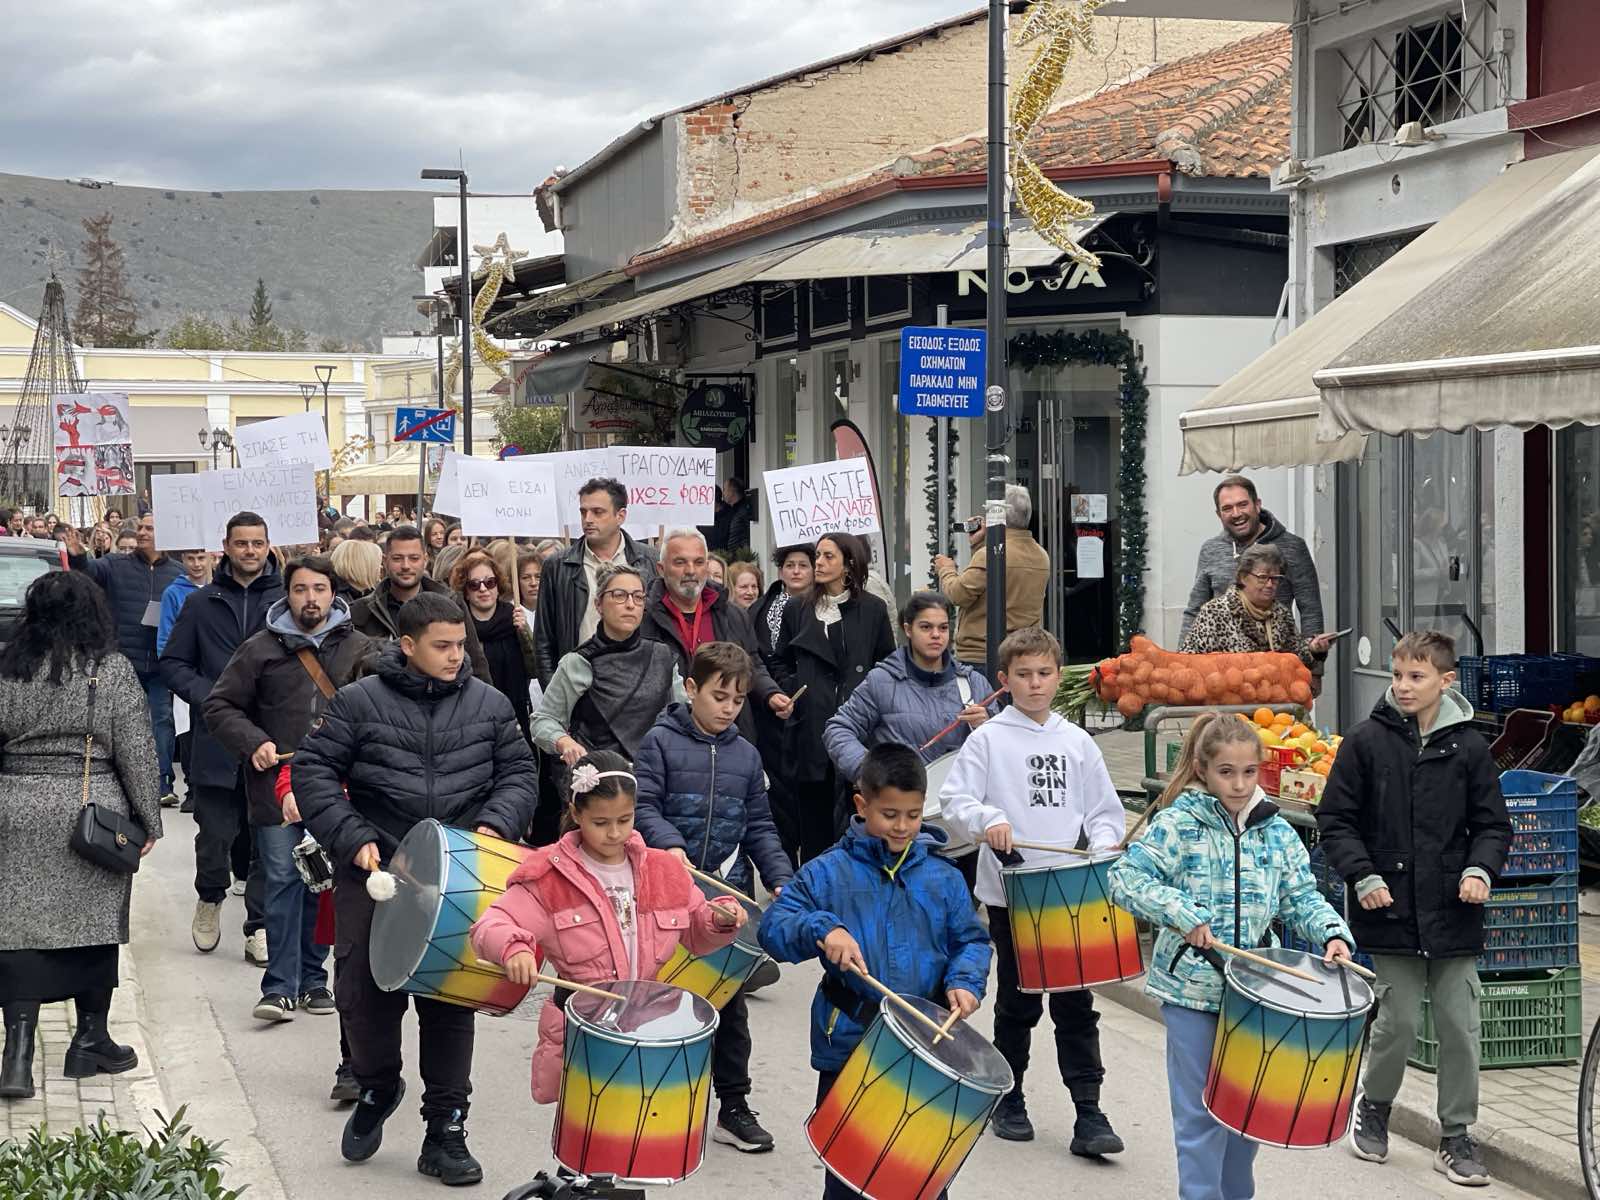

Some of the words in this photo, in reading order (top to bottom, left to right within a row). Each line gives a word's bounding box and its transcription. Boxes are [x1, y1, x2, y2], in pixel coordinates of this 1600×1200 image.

[948, 337, 982, 352] ΕΞΟΔΟΣ
[920, 355, 966, 370] ΟΧΗΜΑΤΩΝ
[909, 374, 954, 389] ΠΑΡΑΚΑΛΩ
[958, 376, 978, 390] ΜΗΝ
[916, 393, 969, 409] ΣΤΑΘΜΕΥΕΤΕ
[242, 437, 289, 459] ΣΠΑΣΕ
[297, 431, 319, 446] ΤΗ
[616, 453, 717, 477] ΤΡΑΓΟΥΔΑΜΕ
[221, 467, 304, 491] ΕΙΜΑΣΤΕ
[463, 482, 489, 498] ΔΕΝ
[508, 480, 547, 496] ΕΙΣΑΙ
[773, 469, 873, 504] ΕΙΜΑΣΤΕ
[213, 498, 241, 514] ΠΙΟ
[249, 489, 312, 510] ΔΥΝΑΤΕΣ
[626, 487, 675, 506] ΙΧΩΣ
[679, 482, 715, 505] ΦΟΒΟ
[495, 506, 532, 518] ΜΟΝΗ
[779, 507, 808, 531] ΠΙΟ
[812, 498, 873, 522] ΔΥΝΑΤΕΣ
[798, 525, 822, 539] ΑΠΟ
